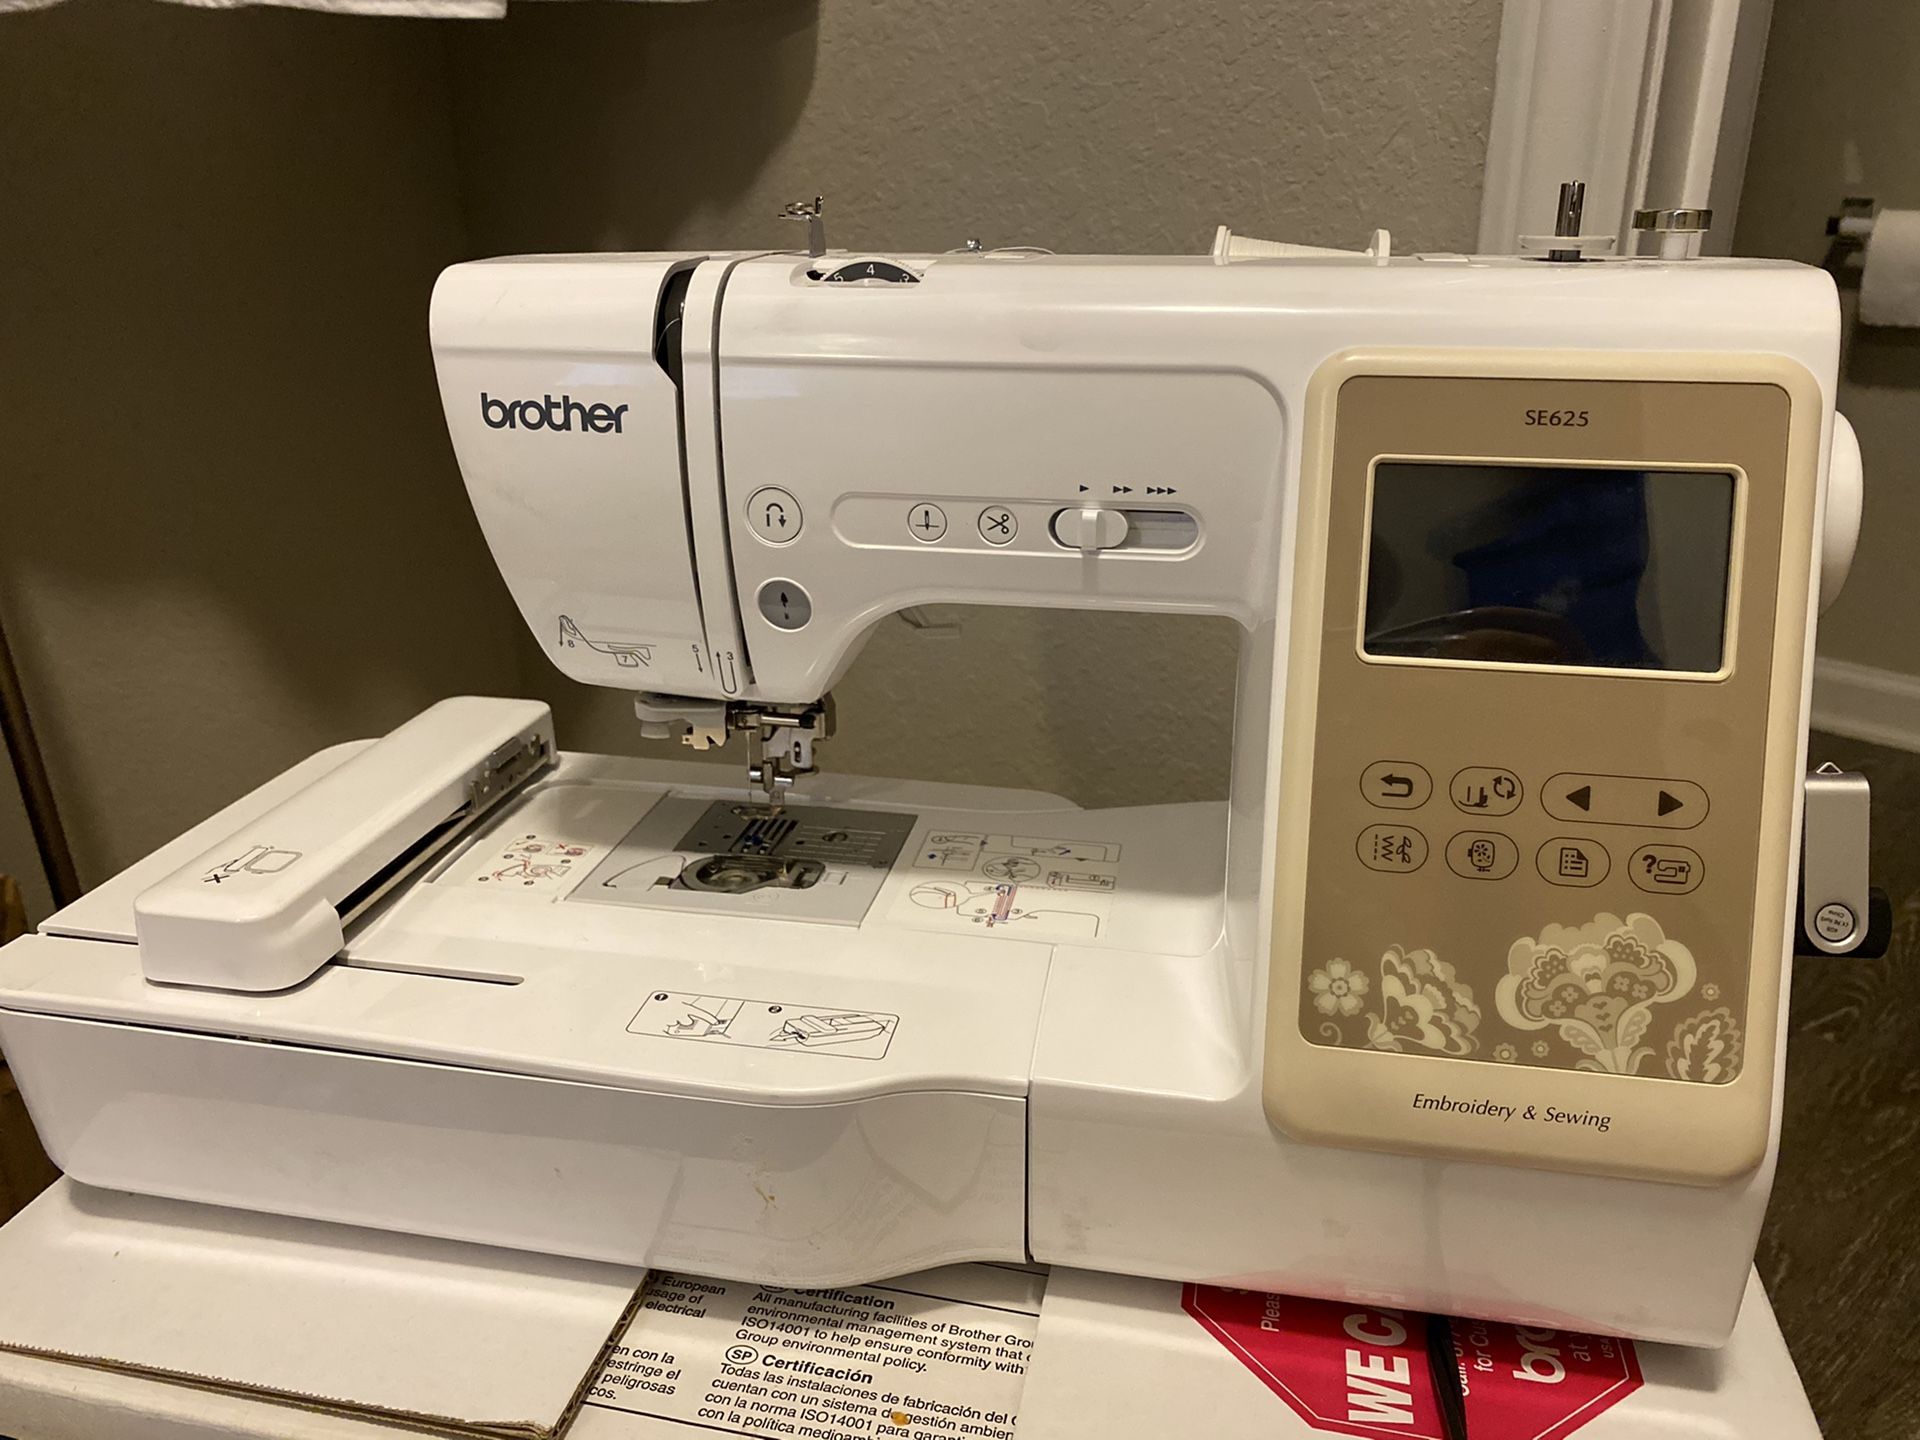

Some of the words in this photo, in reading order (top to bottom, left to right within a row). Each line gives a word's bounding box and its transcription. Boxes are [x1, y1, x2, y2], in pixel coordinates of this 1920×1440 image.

[866, 264, 875, 276] 4
[480, 392, 629, 434] brother
[1524, 409, 1589, 427] SE625
[567, 639, 575, 648] 8
[692, 644, 699, 653] 5
[621, 655, 628, 663] 7
[726, 651, 734, 661] 3
[1412, 1093, 1517, 1123] Embroidery
[1522, 1105, 1537, 1120] &
[1543, 1106, 1611, 1133] Sewing
[661, 1276, 726, 1295] European
[645, 1300, 707, 1319] electrical
[688, 1294, 705, 1304] of
[752, 1292, 772, 1303] All
[773, 1298, 870, 1322] manufacturing
[872, 1310, 928, 1330] facilities
[931, 1322, 947, 1333] of
[949, 1324, 1002, 1343] Brother
[1004, 1334, 1034, 1349] Gro
[1343, 1306, 1407, 1346] C
[747, 1306, 843, 1329] environmental
[845, 1322, 938, 1347] management
[940, 1337, 991, 1355] system
[995, 1346, 1023, 1361] that
[632, 1349, 658, 1361] con
[660, 1352, 675, 1365] la
[735, 1328, 779, 1346] Group
[781, 1339, 881, 1363] environmental
[882, 1355, 928, 1374] policy.
[741, 1316, 810, 1337] ISO14001
[814, 1328, 828, 1340] to
[830, 1331, 861, 1347] help
[864, 1339, 913, 1355] ensure
[917, 1349, 992, 1371] conformity
[995, 1362, 1025, 1375] with
[1568, 1343, 1591, 1362] at
[606, 1358, 663, 1377] estringe
[666, 1369, 682, 1381] el
[731, 1349, 753, 1361] SP
[762, 1354, 874, 1385] Certificación
[1473, 1350, 1494, 1372] for
[601, 1373, 676, 1395] peligrosas
[720, 1362, 761, 1380] Todas
[763, 1371, 784, 1385] las
[787, 1375, 878, 1401] instalaciones
[881, 1392, 900, 1405] de
[903, 1395, 981, 1420] fabricación
[984, 1411, 1009, 1425] del
[1345, 1348, 1414, 1424] WE
[705, 1393, 732, 1406] con
[734, 1396, 748, 1408] la
[750, 1401, 797, 1418] norma
[800, 1408, 873, 1431] ISO14001
[876, 1424, 910, 1439] para
[711, 1379, 768, 1397] cuentan
[771, 1389, 797, 1402] con
[800, 1395, 819, 1406] un
[822, 1398, 878, 1416] sistema
[906, 1413, 956, 1431] gestión
[697, 1407, 725, 1420] con
[727, 1410, 741, 1424] la
[742, 1414, 796, 1434] política
